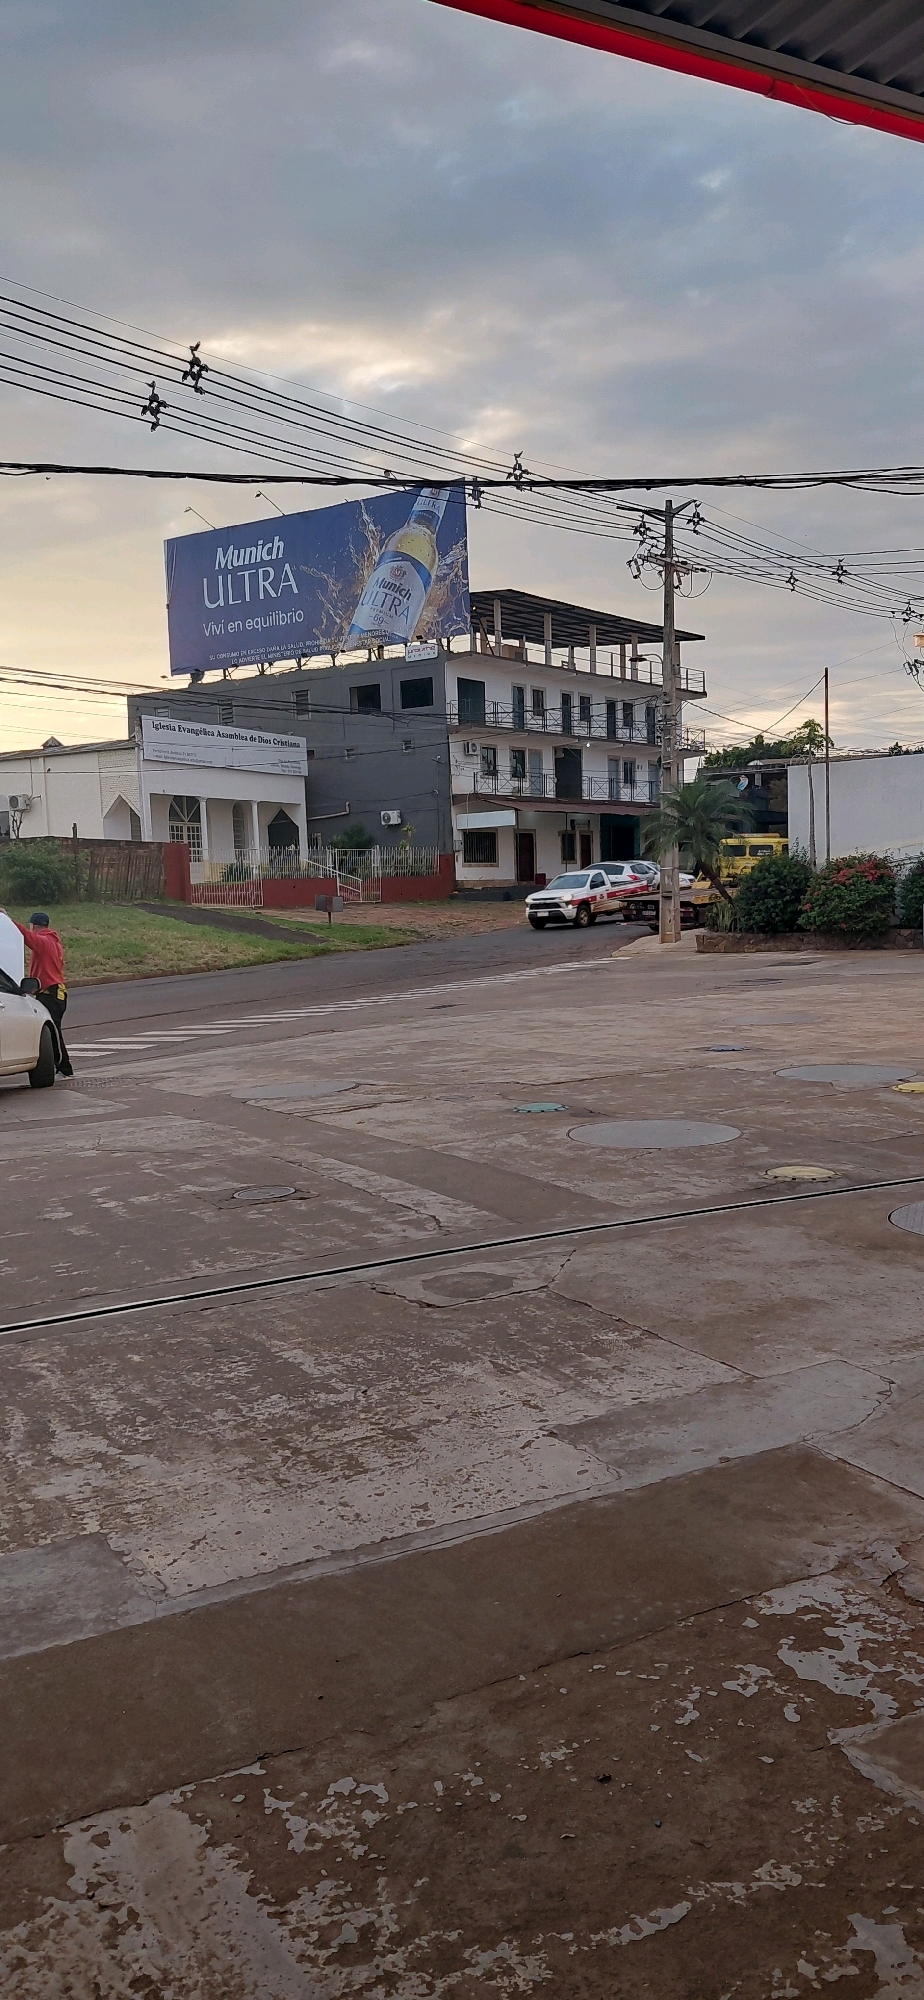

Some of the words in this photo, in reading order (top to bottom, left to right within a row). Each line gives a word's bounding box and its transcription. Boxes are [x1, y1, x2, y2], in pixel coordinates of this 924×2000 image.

[214, 535, 285, 571] Munich
[203, 562, 299, 609] ULTRA
[373, 576, 412, 602] Munich
[203, 619, 225, 637] Viví
[228, 619, 243, 633] en
[245, 607, 304, 632] equilibrio
[361, 590, 411, 626] ULTRA
[216, 651, 240, 660] CONSUMO
[152, 721, 176, 731] Iglesia
[178, 725, 215, 737] Evangélica
[216, 729, 249, 742] Asamblea
[249, 734, 257, 742] de
[258, 736, 272, 745] Dios
[272, 738, 301, 748] Cristiana
